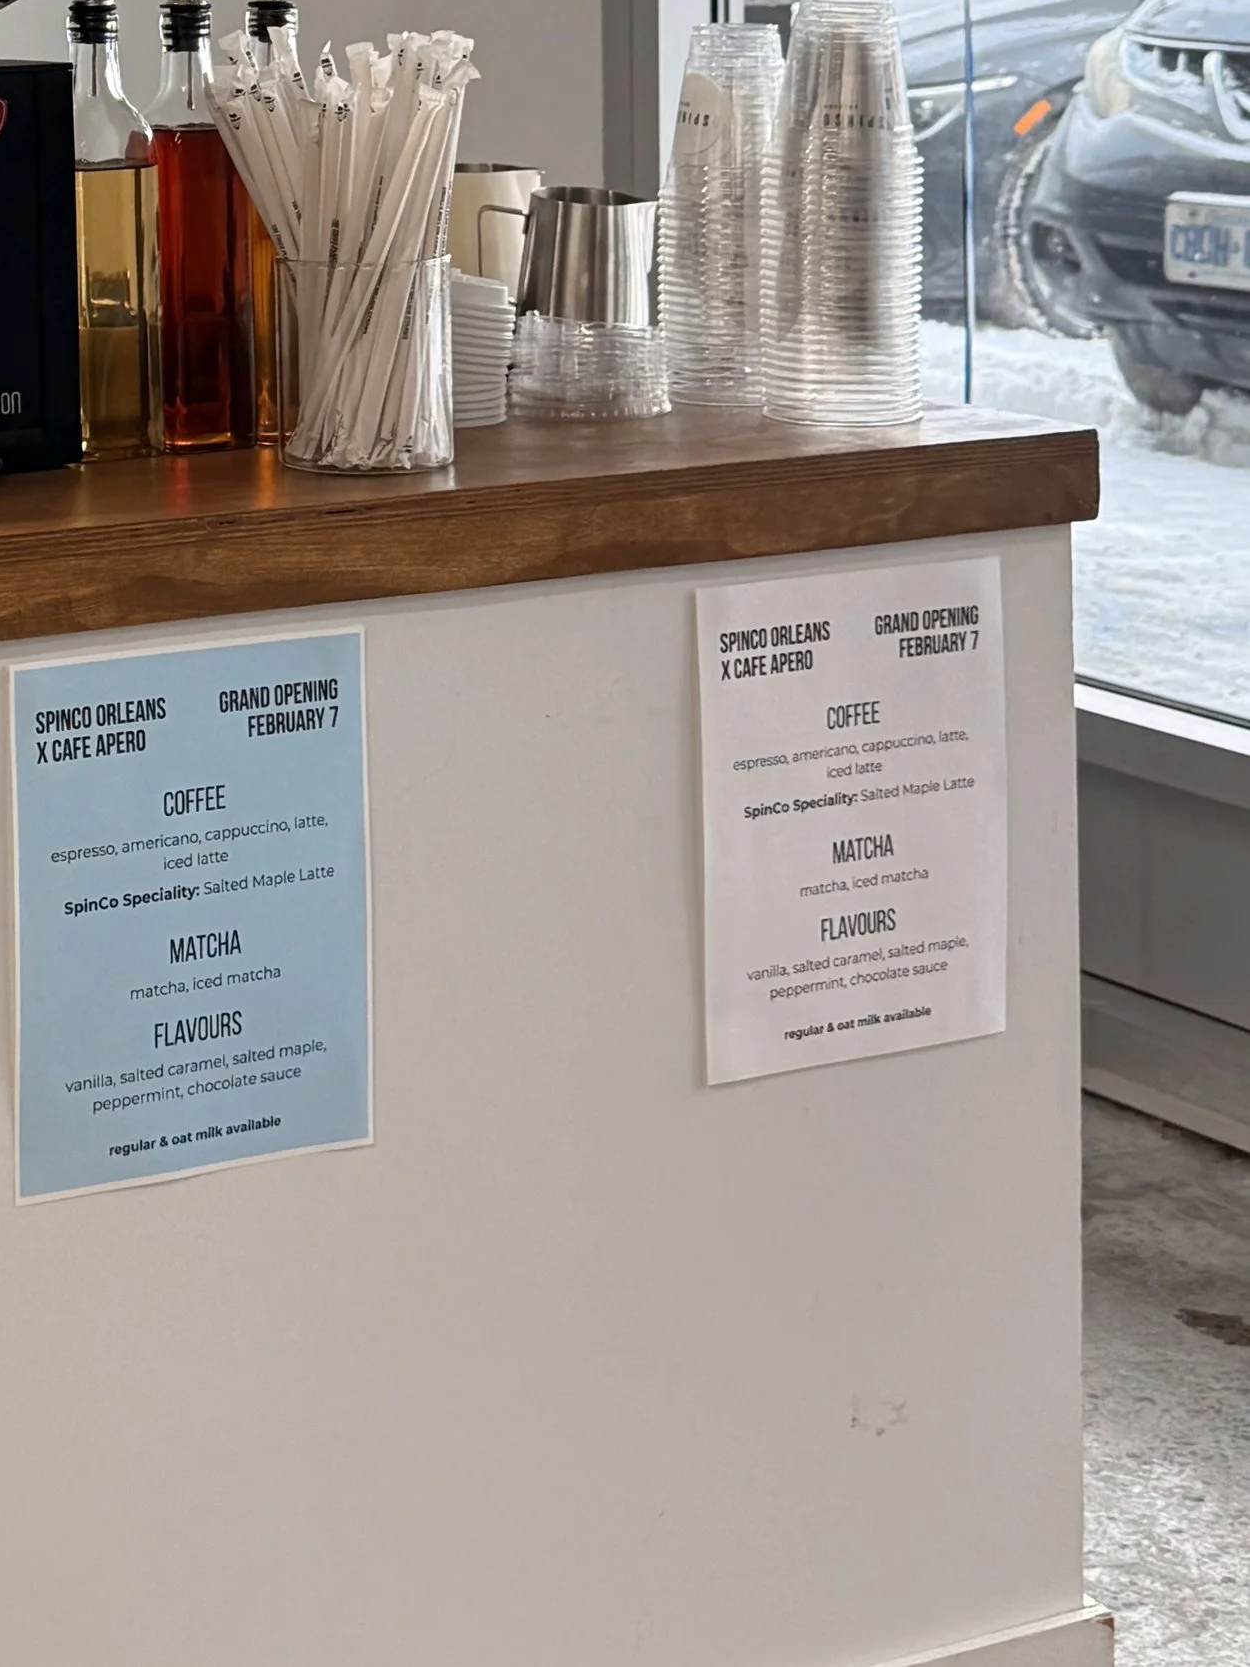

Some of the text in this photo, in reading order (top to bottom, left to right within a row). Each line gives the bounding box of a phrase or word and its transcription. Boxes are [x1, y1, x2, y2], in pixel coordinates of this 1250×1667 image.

[719, 620, 831, 654] SPINCO ORLEANS
[874, 604, 979, 636] GRAND OPENING
[898, 629, 979, 659] FEBRUARY 7
[720, 649, 813, 681] X CAFE APERO
[218, 677, 338, 714] GRAND OPENING
[35, 696, 167, 735] SPINCO ORLEANS
[247, 704, 339, 738] FEBRUARY 7
[826, 700, 881, 730] COFFEE
[36, 728, 146, 765] X CAFE APERO
[732, 730, 969, 772] espresso, americano, cappuccino, latte,
[826, 761, 883, 779] iced latte
[163, 784, 226, 817] COFFEE
[743, 777, 975, 821] SpinCo Speciality: Salted Maple Latte
[50, 815, 328, 864] espresso, americano, cappuccino, latte,
[832, 833, 895, 864] MATCHA
[163, 850, 229, 871] iced latte
[63, 866, 334, 917] SpinCo Speciality: Salted Maple Latte
[799, 867, 929, 897] matcha, iced matcha
[820, 907, 897, 942] FLAVOURS
[169, 929, 242, 964] MATCHA
[746, 935, 969, 981] vanilla, salted caramel, salted maple,
[130, 965, 281, 1000] matcha, iced matcha
[769, 960, 949, 1001] peppermint, chocolate sauce
[154, 1009, 242, 1049] FLAVOURS
[783, 1005, 932, 1041] regular & oat milk available
[64, 1039, 327, 1093] vanilla, salted caramel, salted maple,
[92, 1066, 302, 1115] peppermint, chocolate sauce
[109, 1115, 282, 1157] regular & oat milk available
